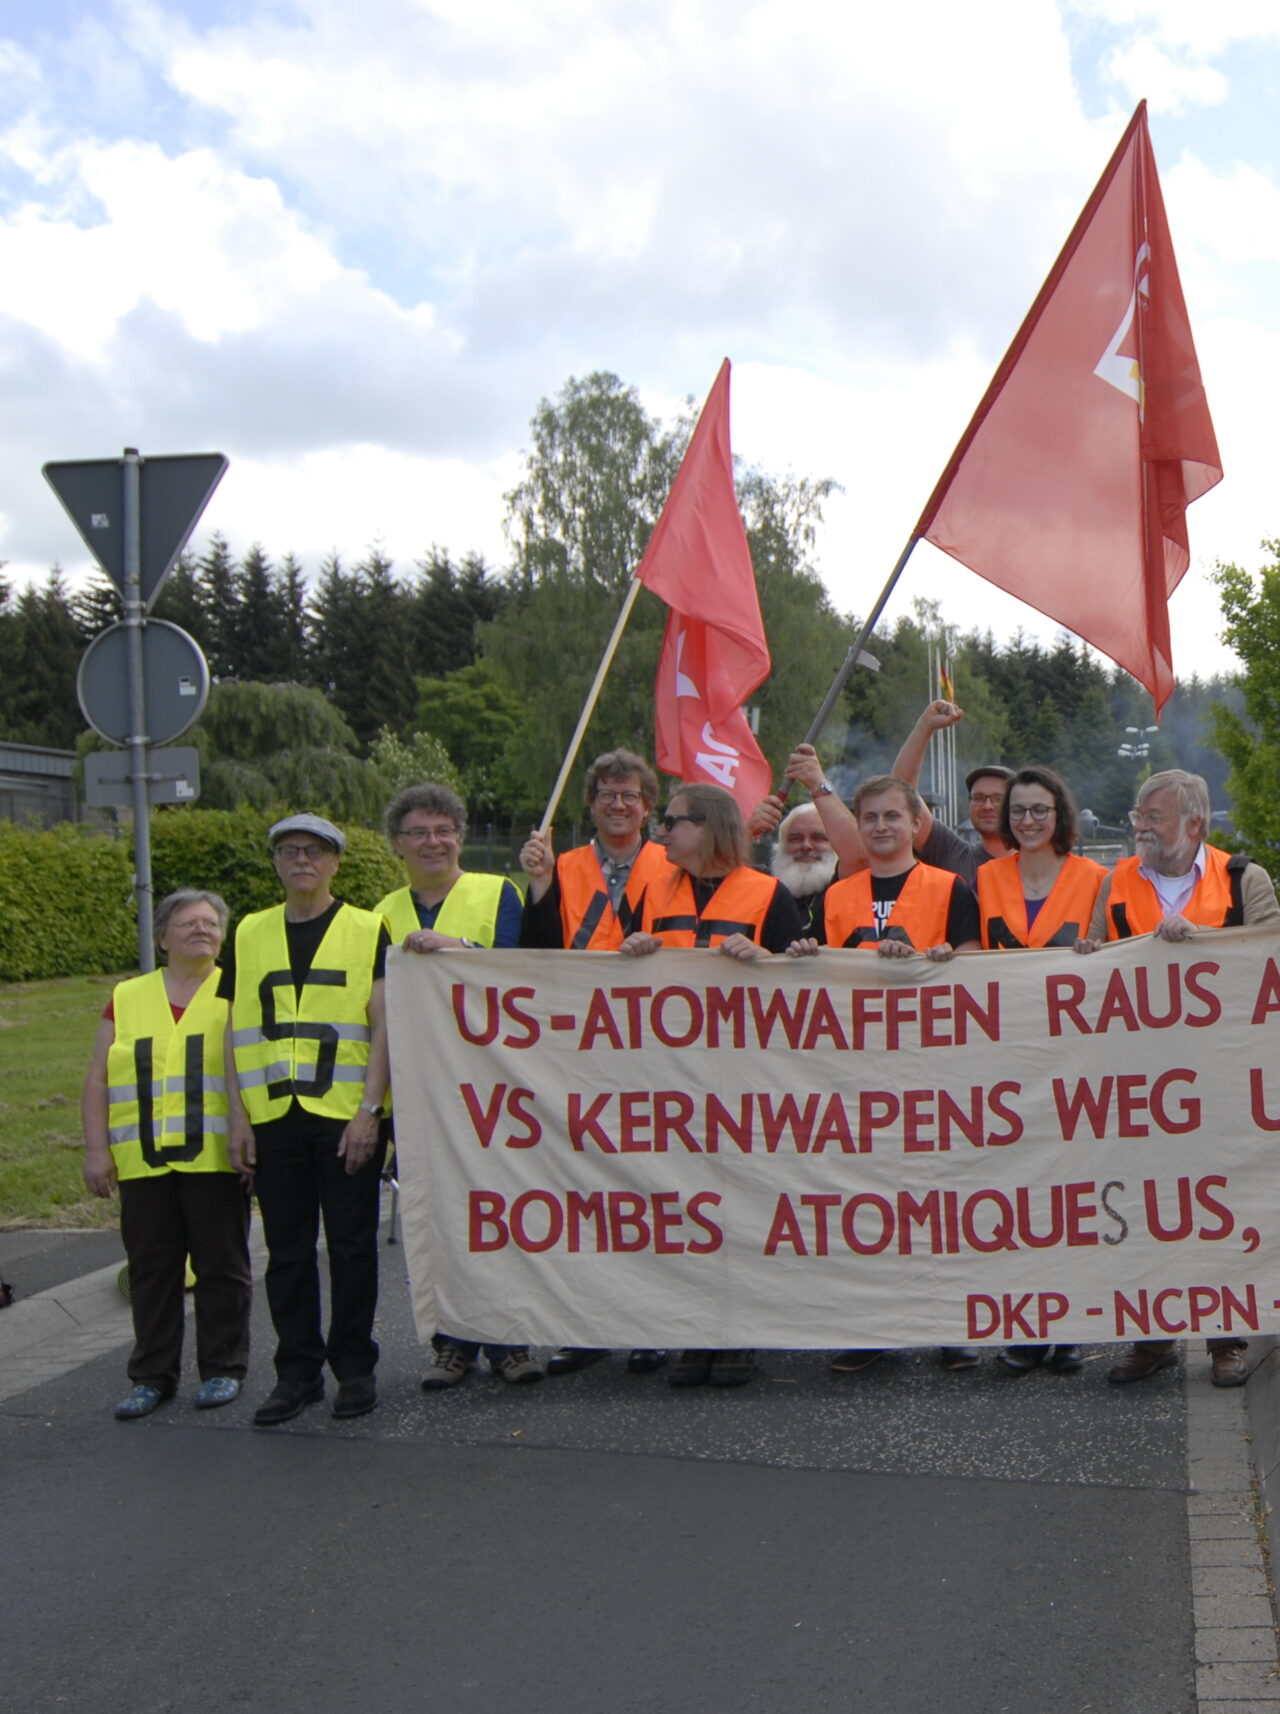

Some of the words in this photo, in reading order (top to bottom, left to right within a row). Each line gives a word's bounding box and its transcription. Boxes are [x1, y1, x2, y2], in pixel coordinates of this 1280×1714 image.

[452, 981, 1001, 1051] US-ATOMWAFFEN
[1045, 961, 1222, 1037] RAUS
[460, 1083, 542, 1149] VS
[567, 1080, 1024, 1154] KERNWAPENS
[1052, 1068, 1201, 1141] WEG
[467, 1190, 724, 1255] BOMBES
[764, 1180, 1129, 1257] ATOMIQUES
[1145, 1175, 1261, 1254] US,
[966, 1293, 1069, 1340] DKP
[1114, 1284, 1260, 1337] NCPN
